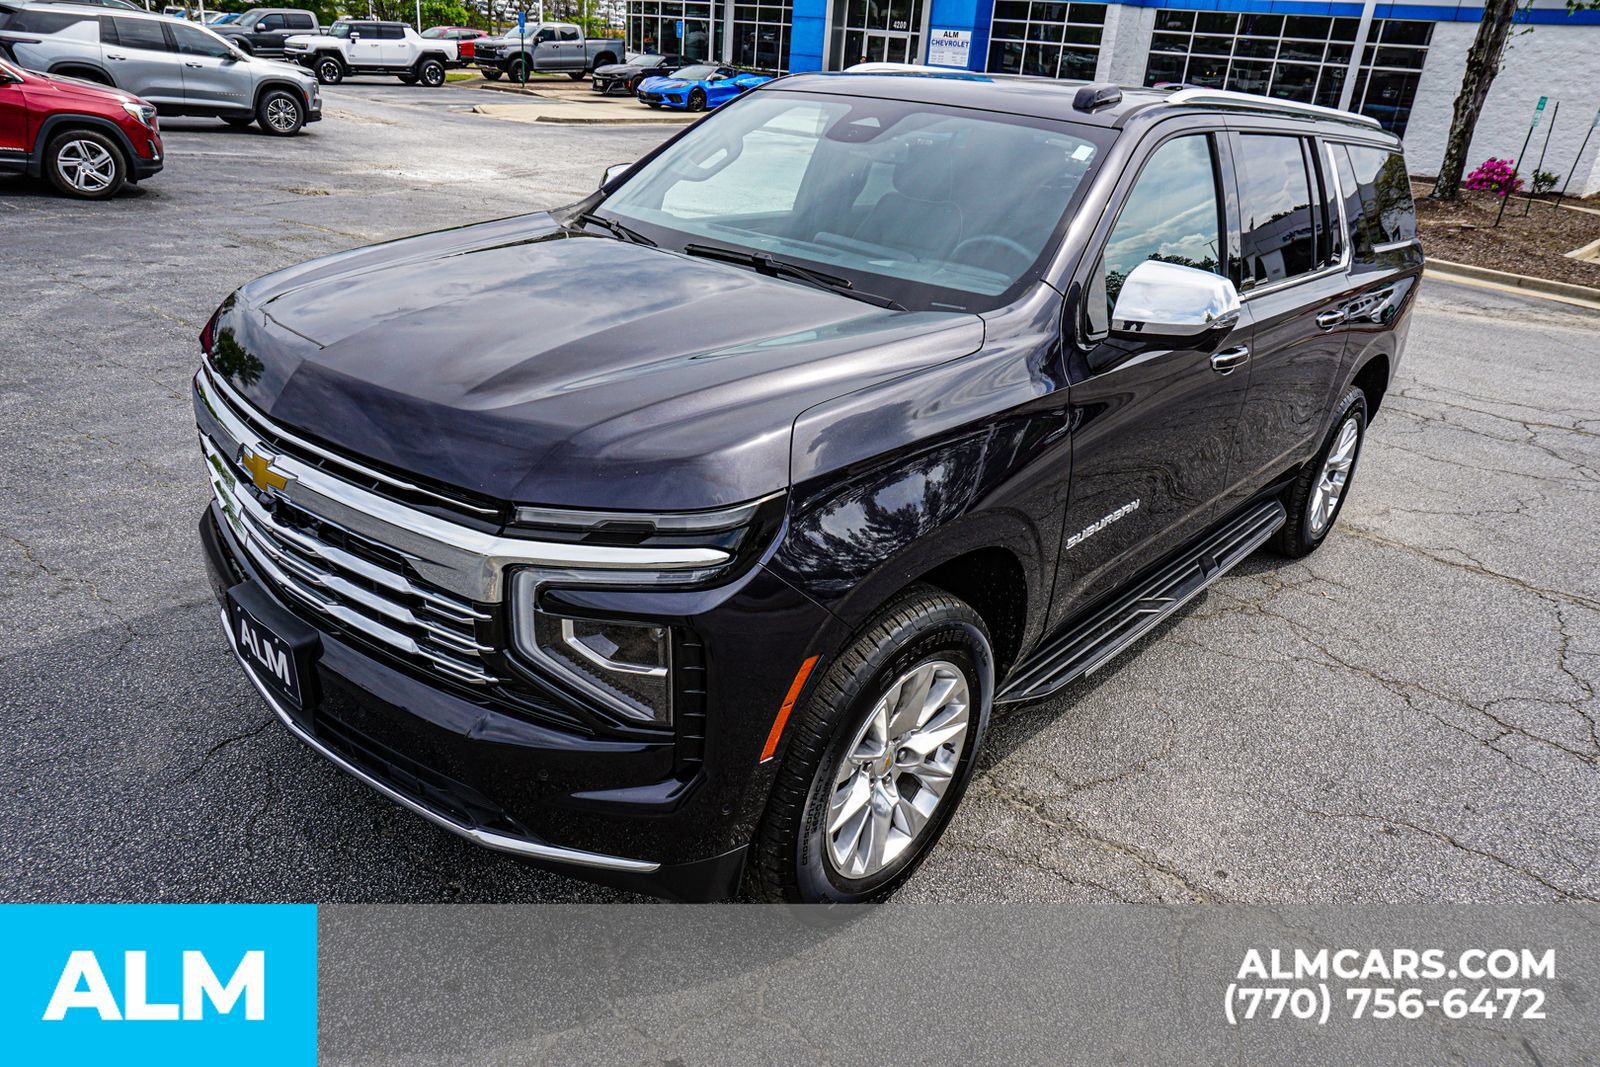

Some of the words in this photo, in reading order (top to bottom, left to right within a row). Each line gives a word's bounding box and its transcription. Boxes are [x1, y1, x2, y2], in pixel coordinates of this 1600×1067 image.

[931, 39, 969, 48] CHEVROLET
[1065, 498, 1140, 550] SUBURBAN
[241, 618, 291, 686] ALM
